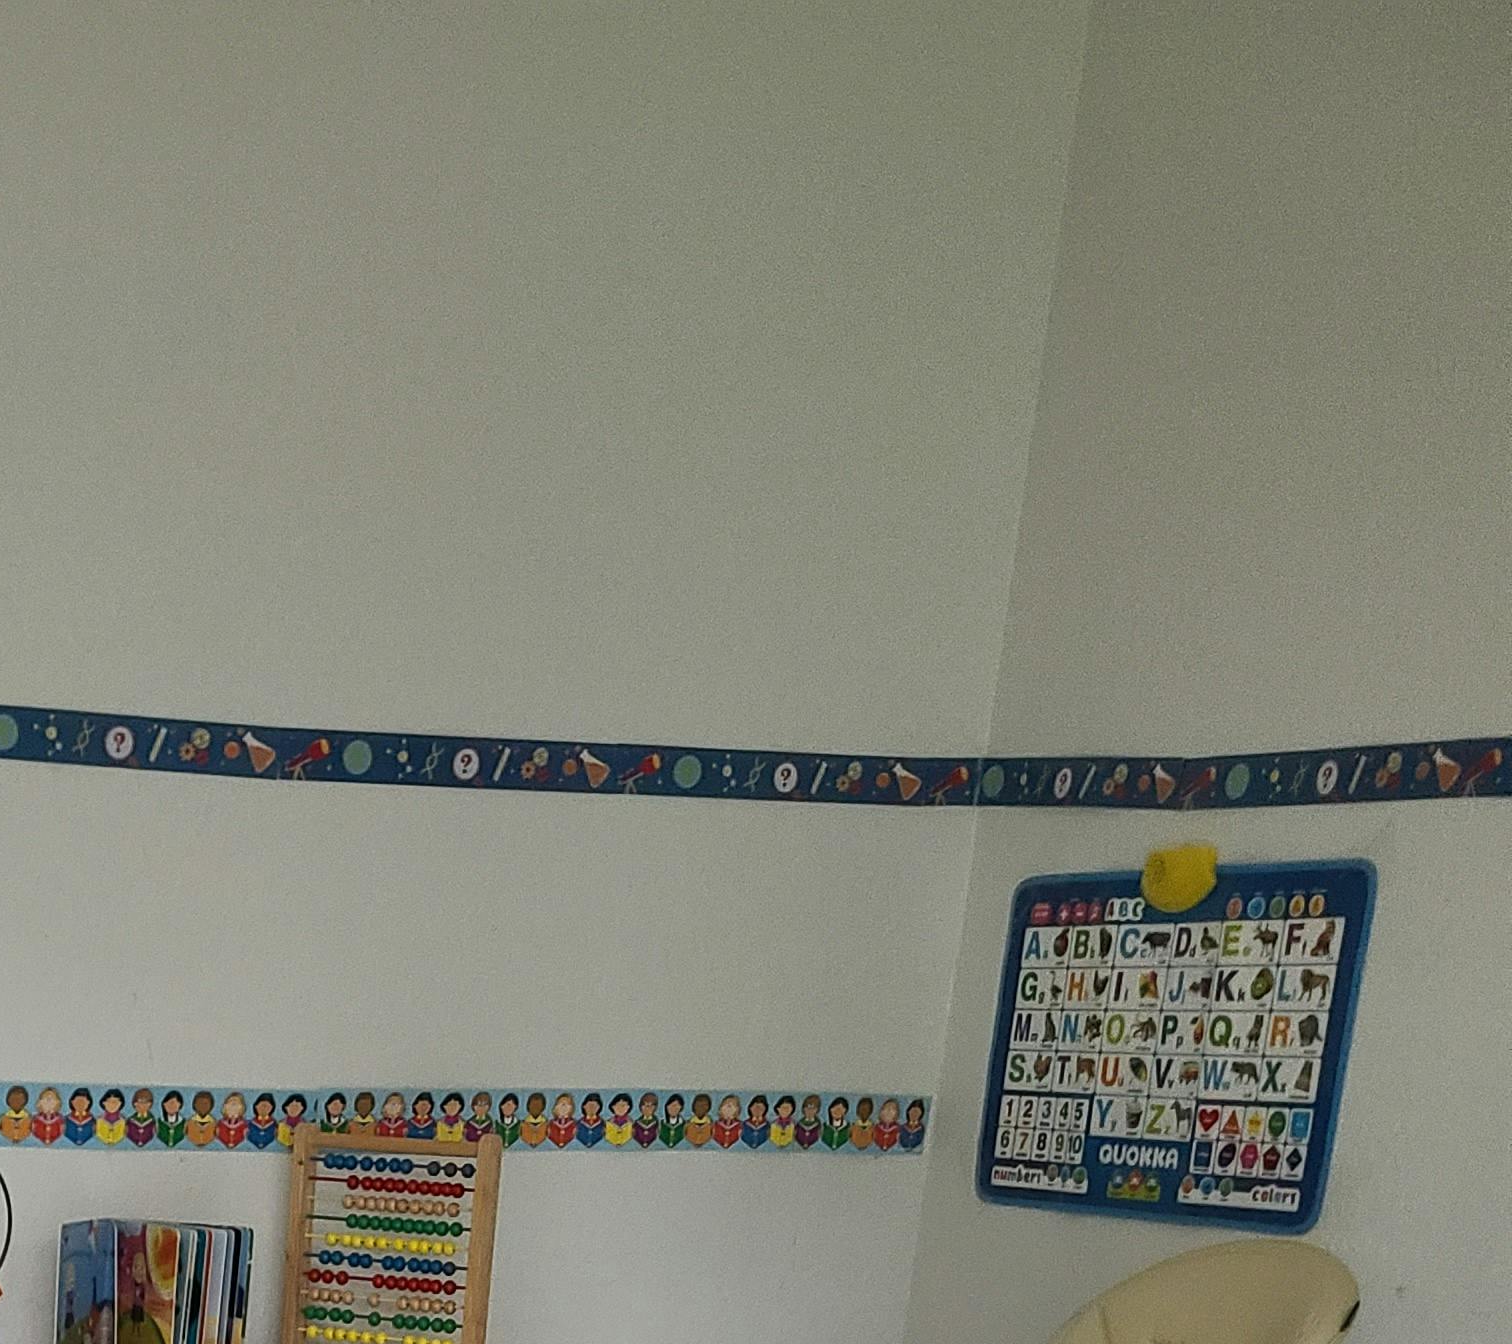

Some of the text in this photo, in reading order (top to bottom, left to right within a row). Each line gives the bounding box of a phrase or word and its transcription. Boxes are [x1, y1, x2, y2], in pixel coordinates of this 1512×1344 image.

[1107, 898, 1144, 919] ABC
[1025, 923, 1305, 960] A B C D E F
[1021, 972, 1039, 1001] G
[1068, 972, 1085, 1001] H
[1168, 971, 1185, 1002] J
[1215, 970, 1239, 1001] K
[1278, 970, 1292, 1002] L
[1014, 1013, 1291, 1047] M N O P Q R
[1008, 1053, 1282, 1092] S T U V W X
[1023, 1100, 1034, 1118] 2
[1042, 1101, 1051, 1119] 3
[1060, 1101, 1069, 1120] 4
[1074, 1102, 1084, 1121] 5
[1096, 1100, 1113, 1128] Y
[1145, 1105, 1165, 1134] Z
[1000, 1131, 1082, 1154] 6 7 8 9 10
[1099, 1144, 1179, 1170] QUOKKA
[994, 1165, 1041, 1184] numbers
[1252, 1187, 1297, 1205] colors
